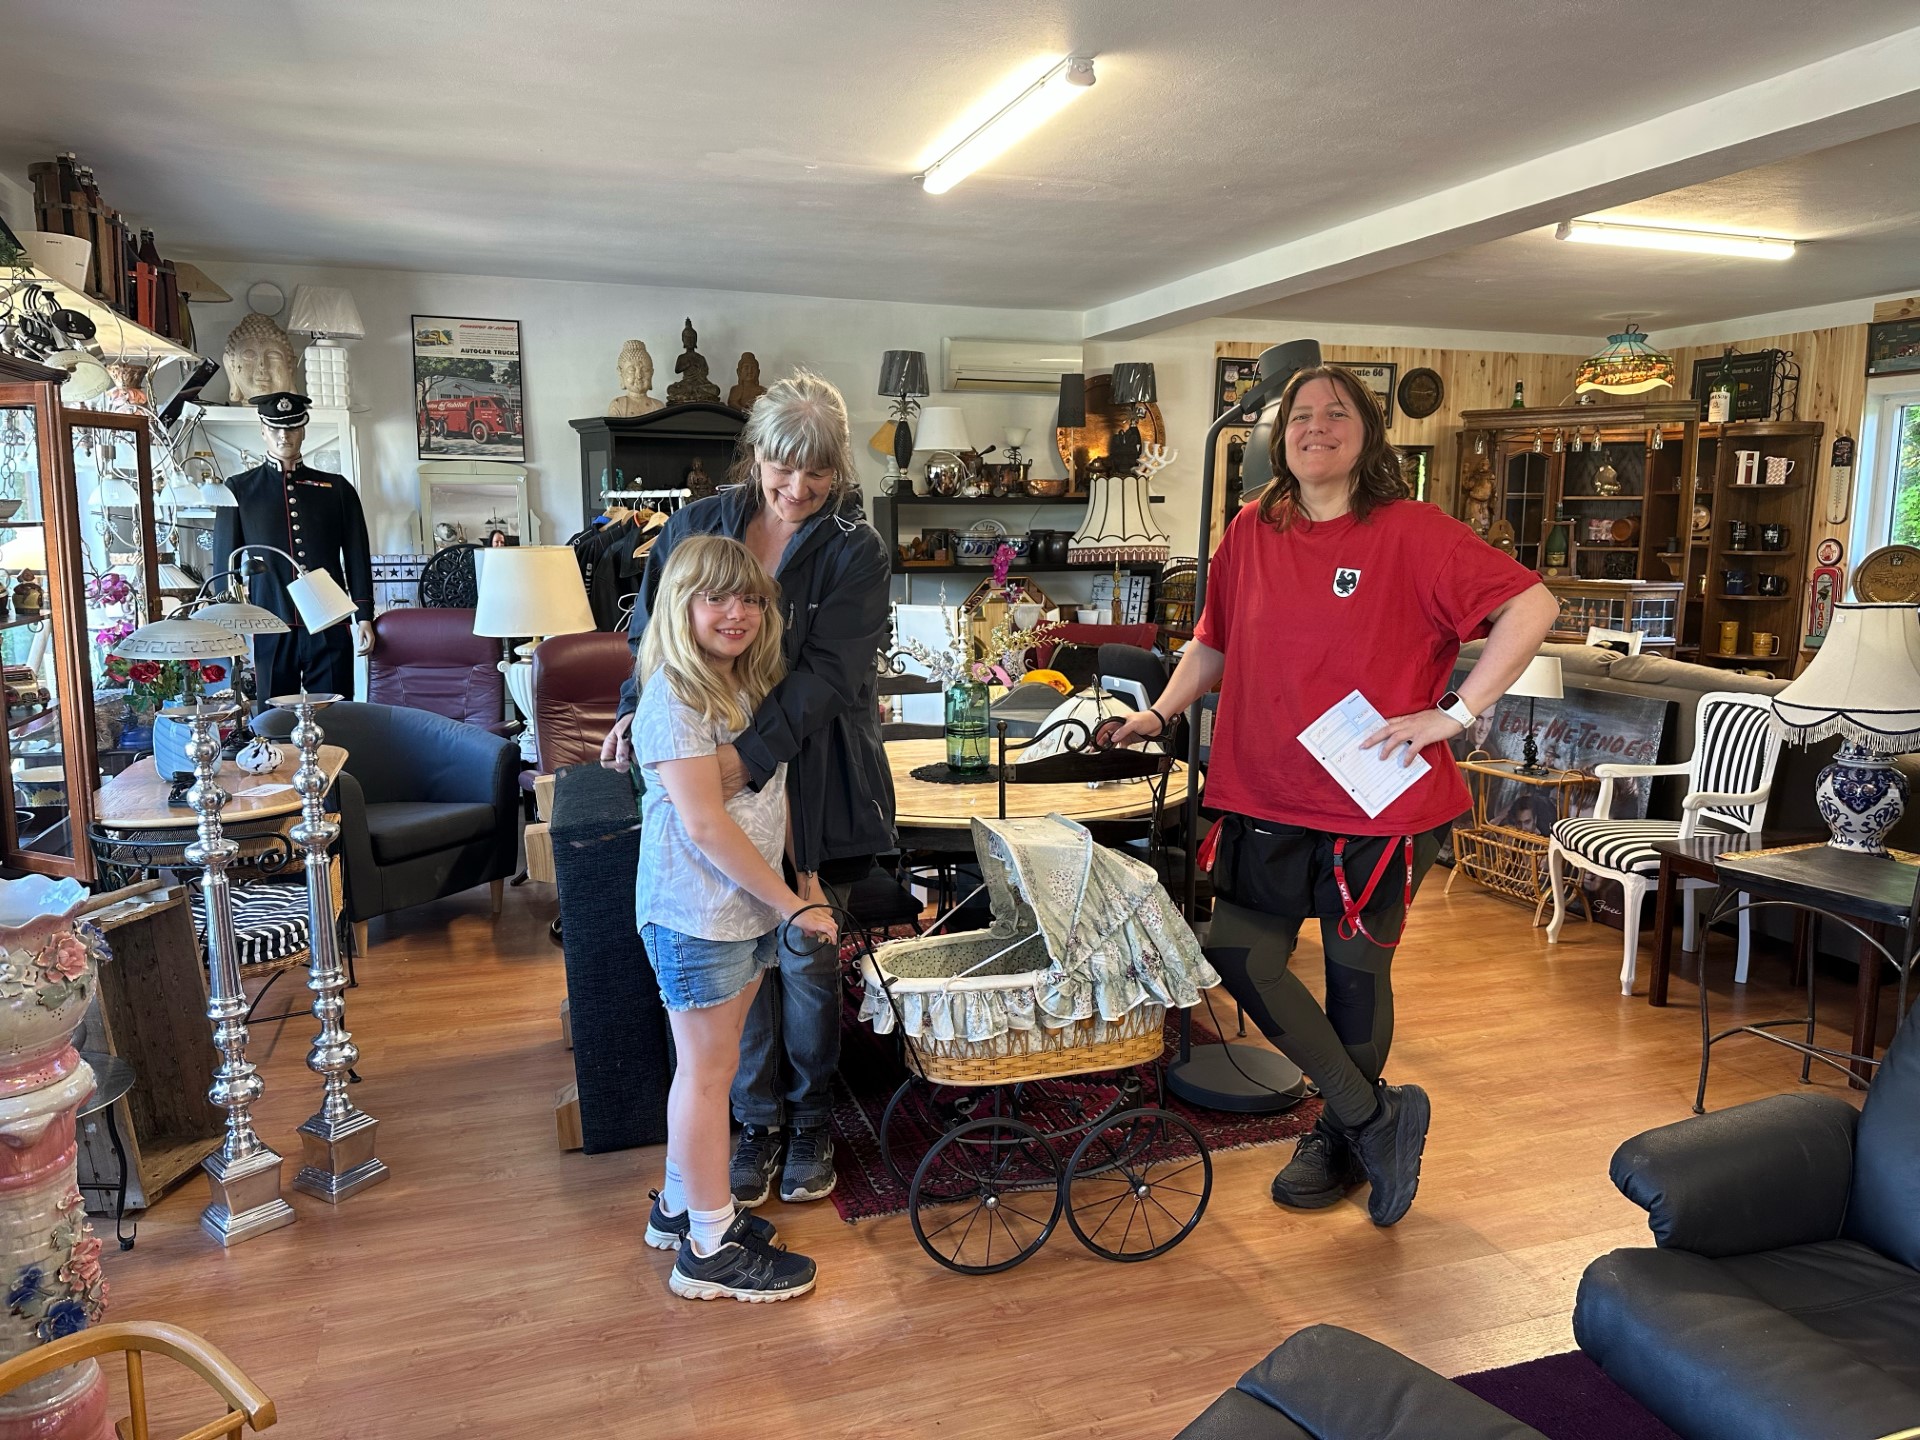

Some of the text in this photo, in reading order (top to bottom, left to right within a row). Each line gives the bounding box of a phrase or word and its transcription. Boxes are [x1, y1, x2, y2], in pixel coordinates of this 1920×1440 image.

[1351, 368, 1384, 377] oute 66
[1817, 602, 1825, 630] GAS
